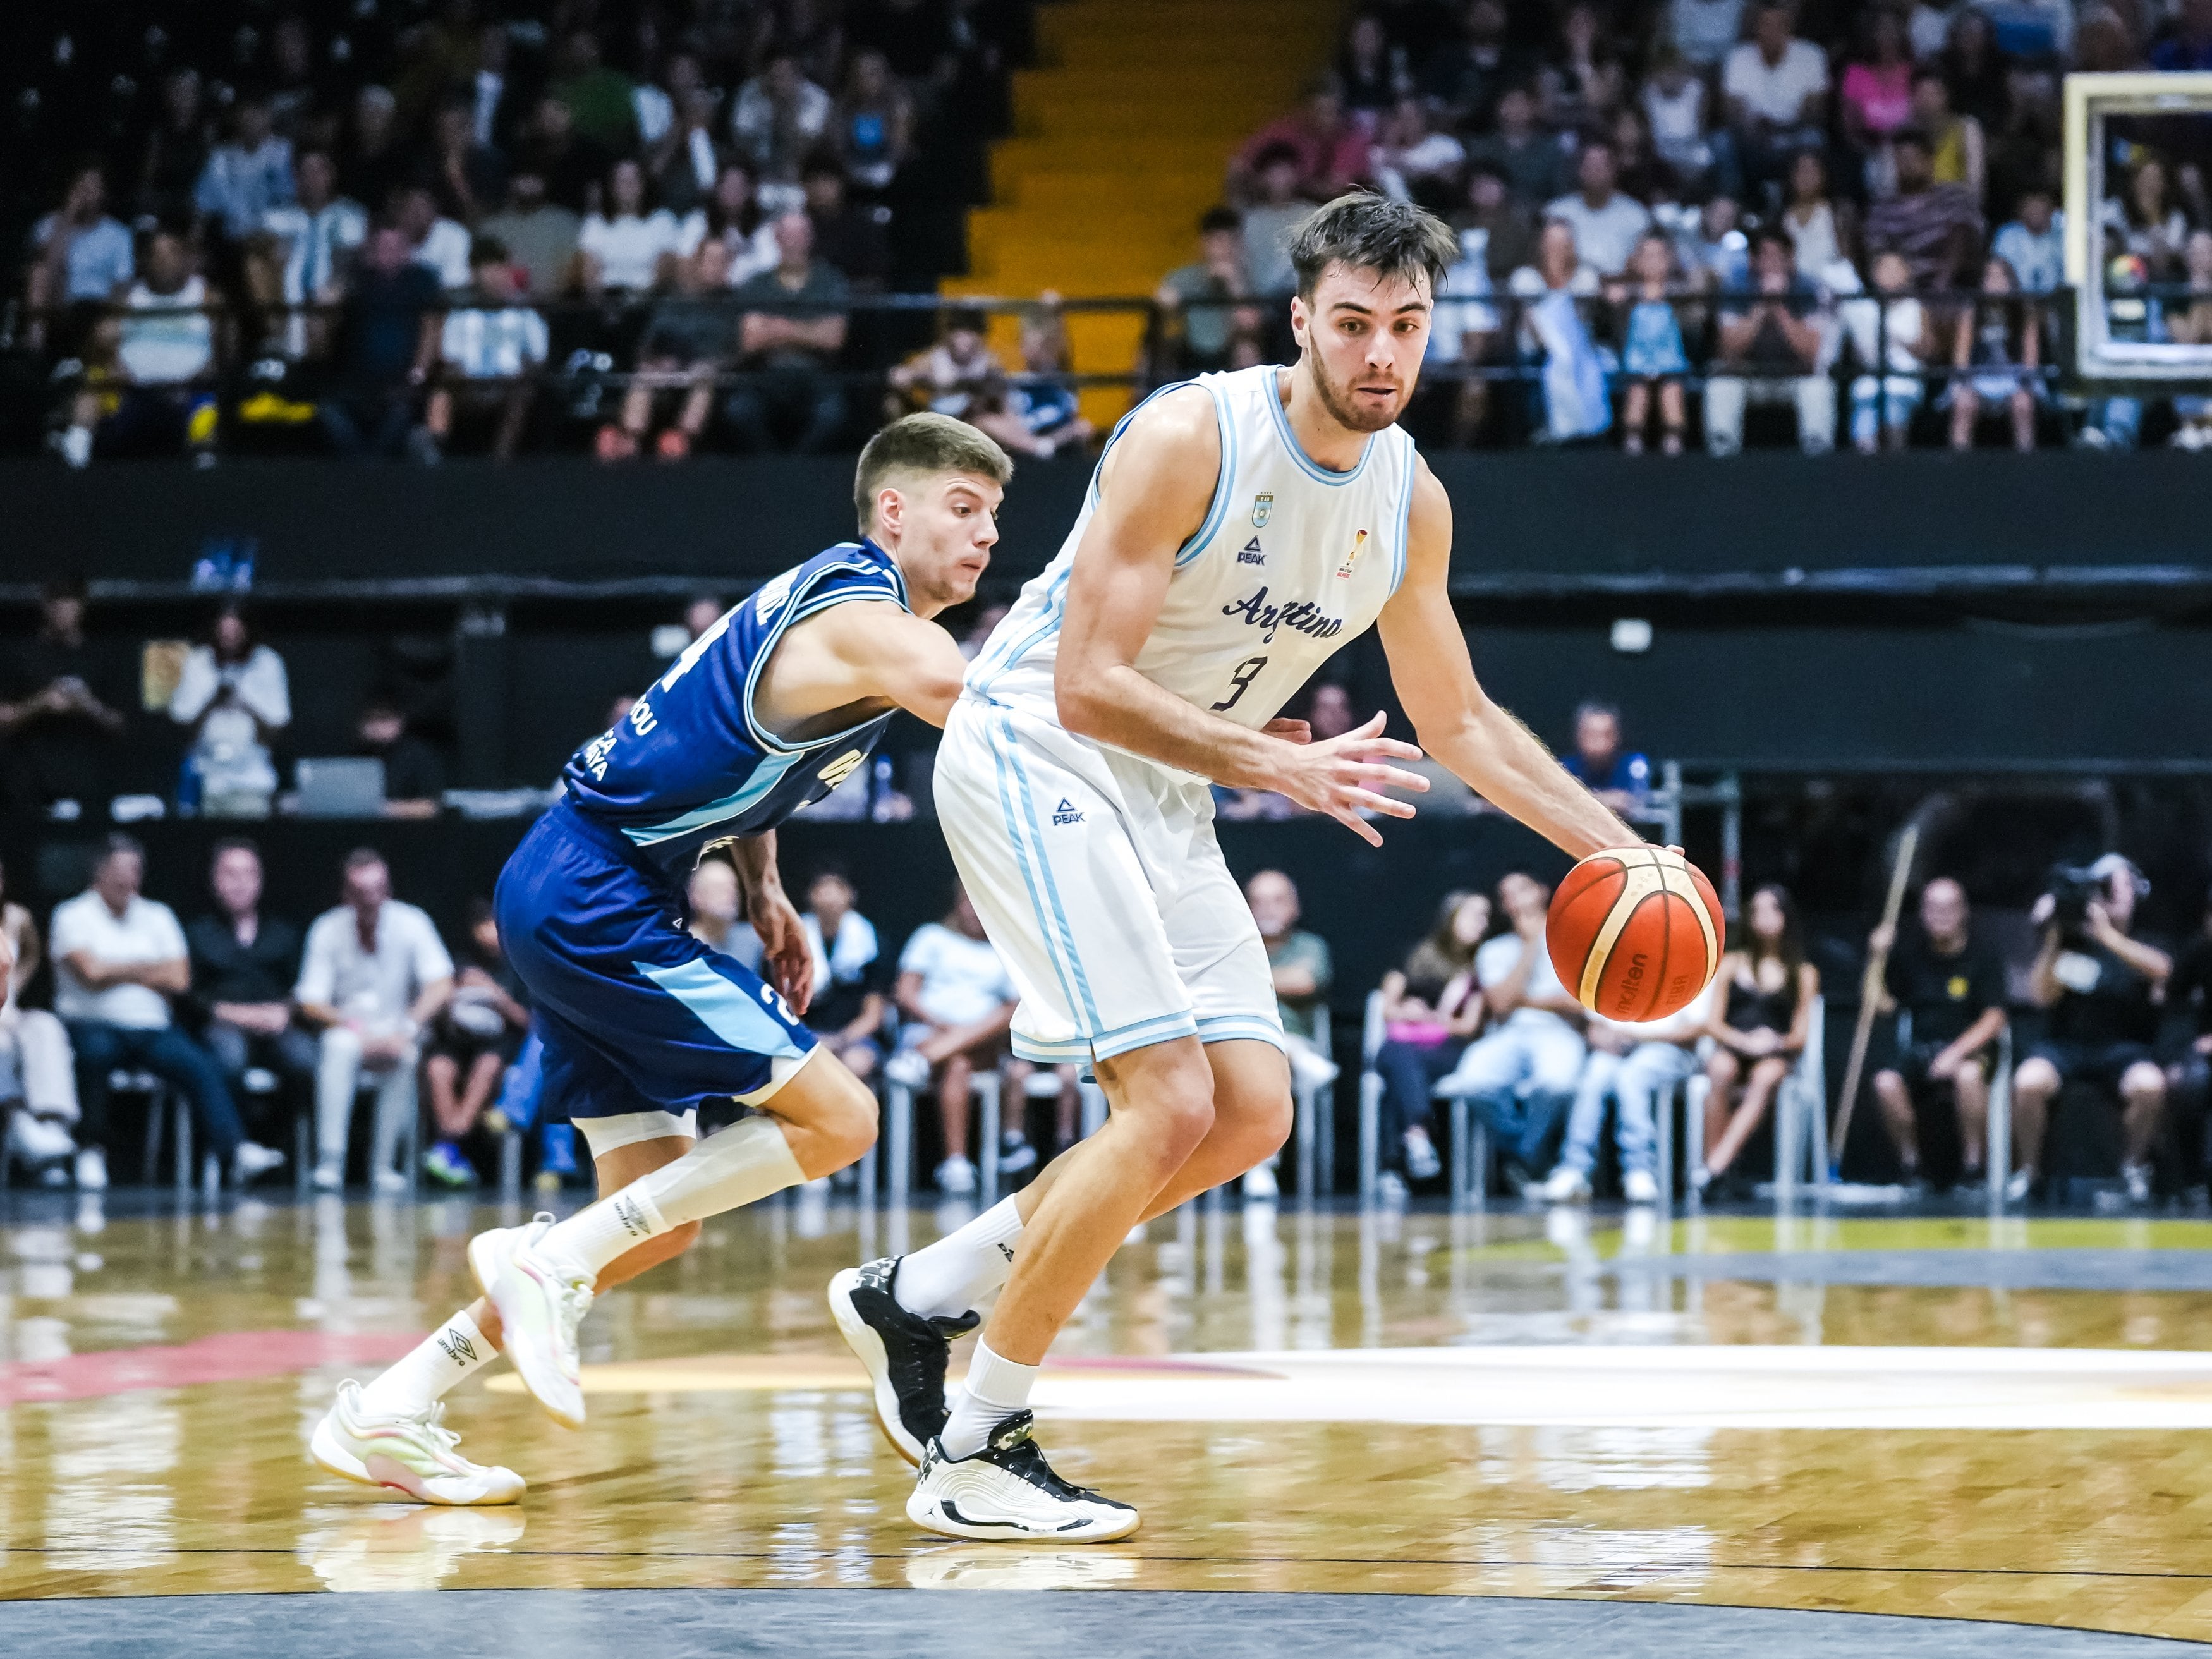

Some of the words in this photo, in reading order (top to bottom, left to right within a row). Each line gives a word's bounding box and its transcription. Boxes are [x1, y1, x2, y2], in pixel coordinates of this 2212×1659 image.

[1237, 551, 1267, 566] PEAK
[1208, 656, 1268, 711] 3
[1052, 812, 1086, 826] PEAK
[1615, 953, 1648, 1014] molten
[437, 1337, 465, 1366] umbro
